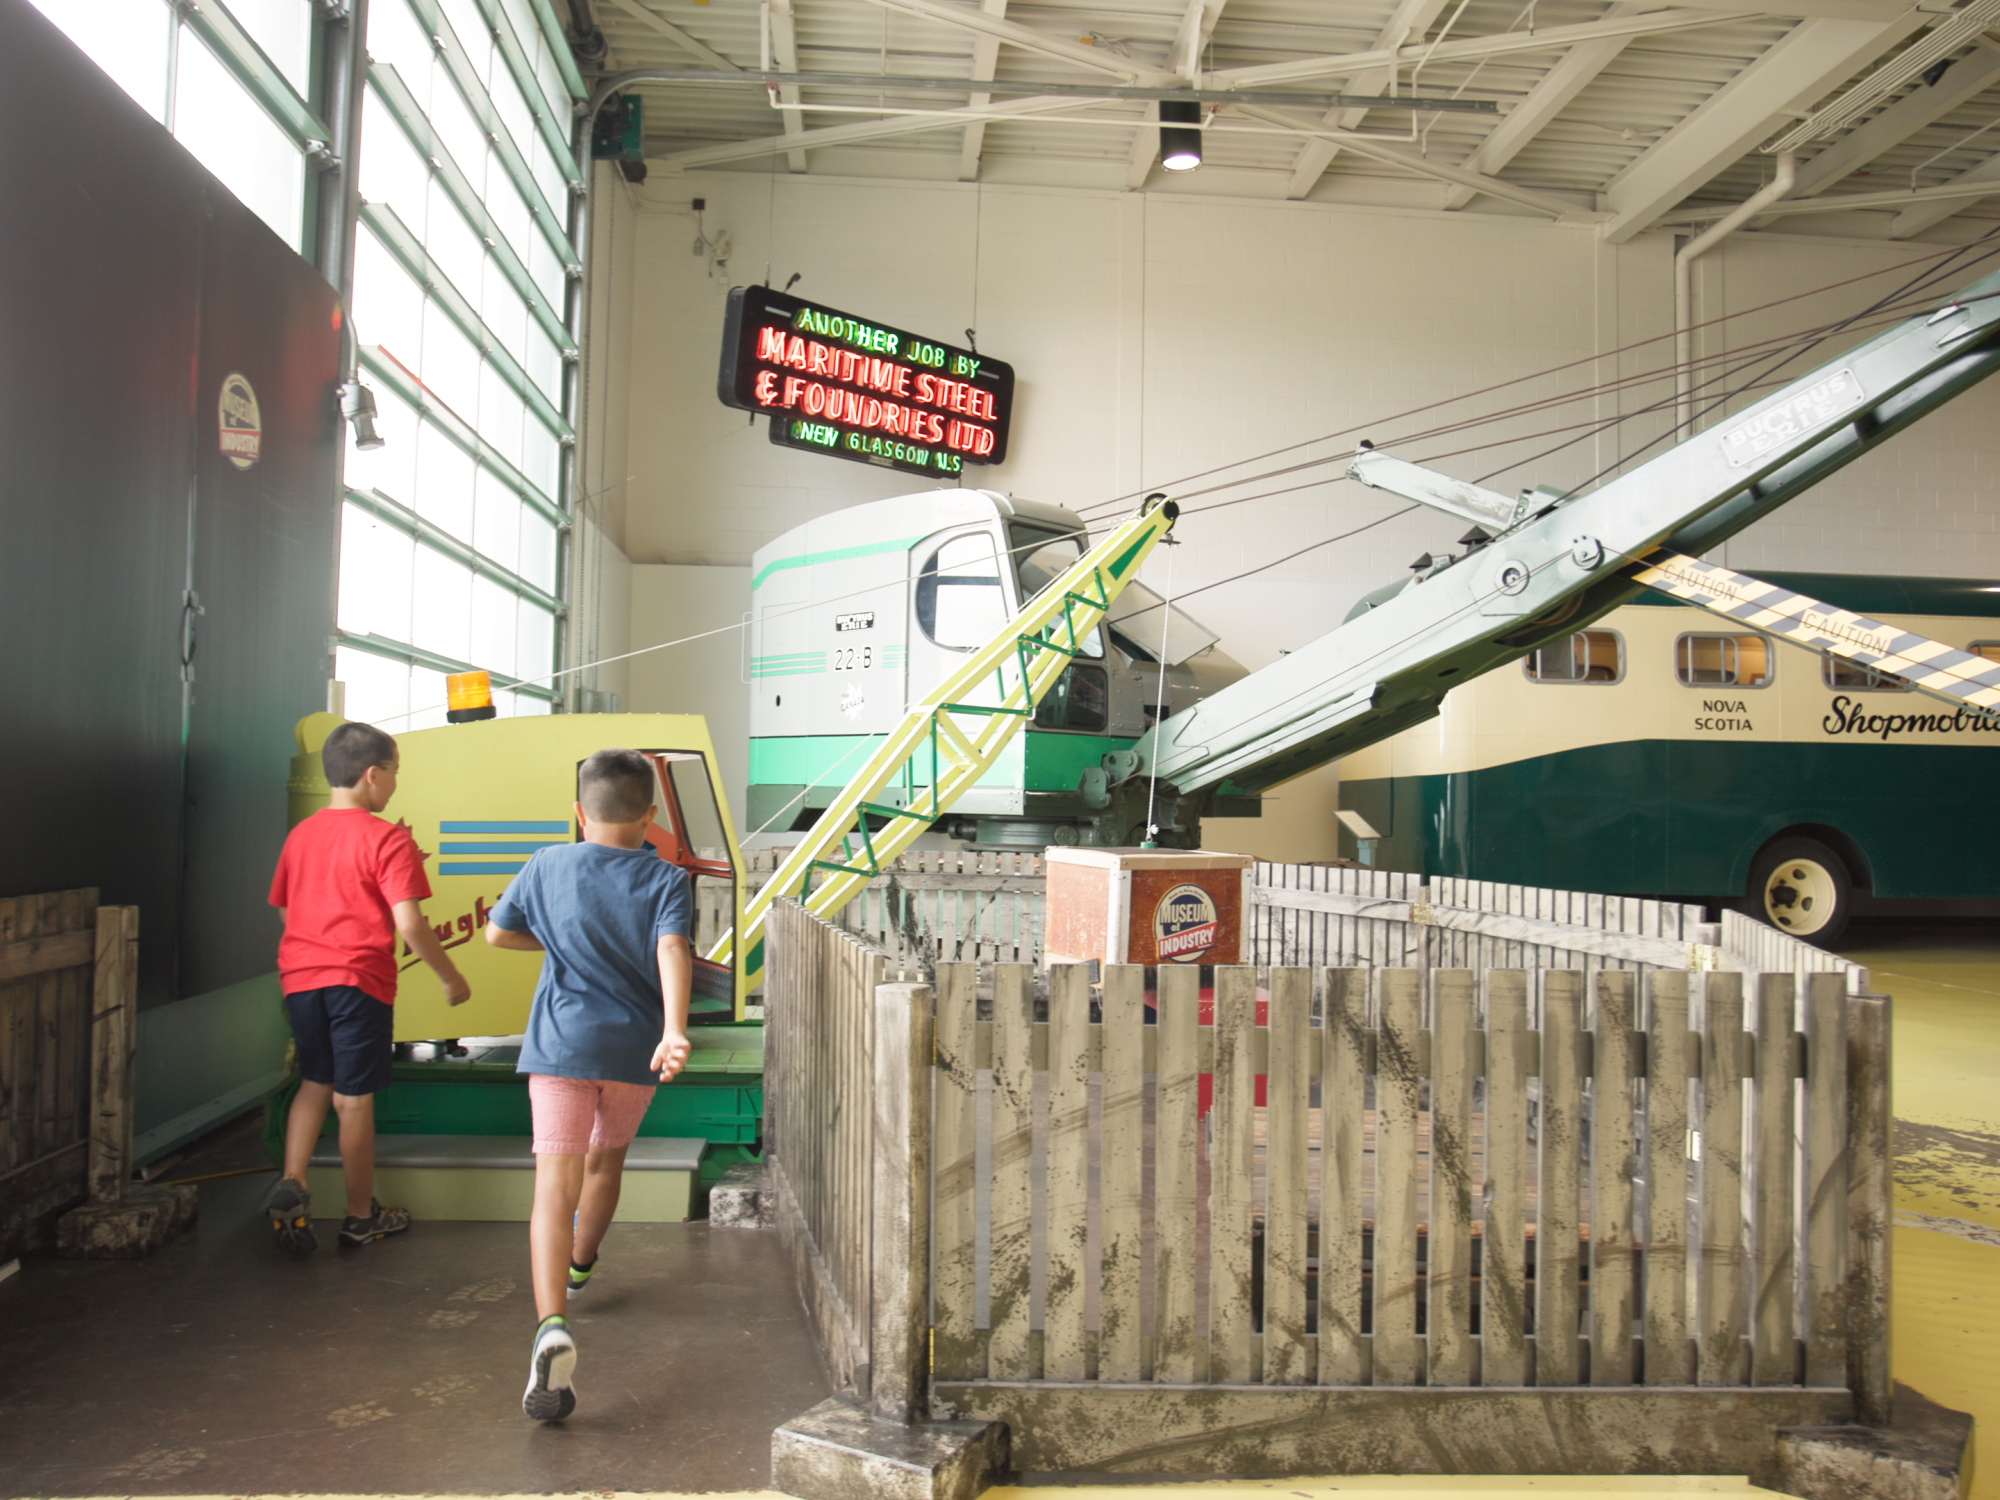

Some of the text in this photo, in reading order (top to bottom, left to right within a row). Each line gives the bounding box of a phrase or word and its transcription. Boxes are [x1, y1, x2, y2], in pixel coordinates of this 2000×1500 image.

[796, 307, 981, 379] ANOTHER JOB BY
[759, 326, 998, 420] MARITIME STEEL
[758, 370, 996, 456] & FOUNDRIES LTD
[1728, 375, 1847, 448] BUCYRUS
[1750, 400, 1838, 454] ERIE
[798, 420, 840, 448] NEW
[847, 432, 930, 467] GLASGOW
[1663, 563, 1738, 602] CAUTION
[841, 621, 868, 631] ERIE
[1803, 612, 1888, 656] CAUTION
[1695, 717, 1753, 732] SCOTIA
[1703, 699, 1747, 714] NOVA
[1160, 903, 1209, 924] MUSEUM
[1170, 923, 1180, 932] of
[1160, 926, 1214, 957] INDUSTRY
